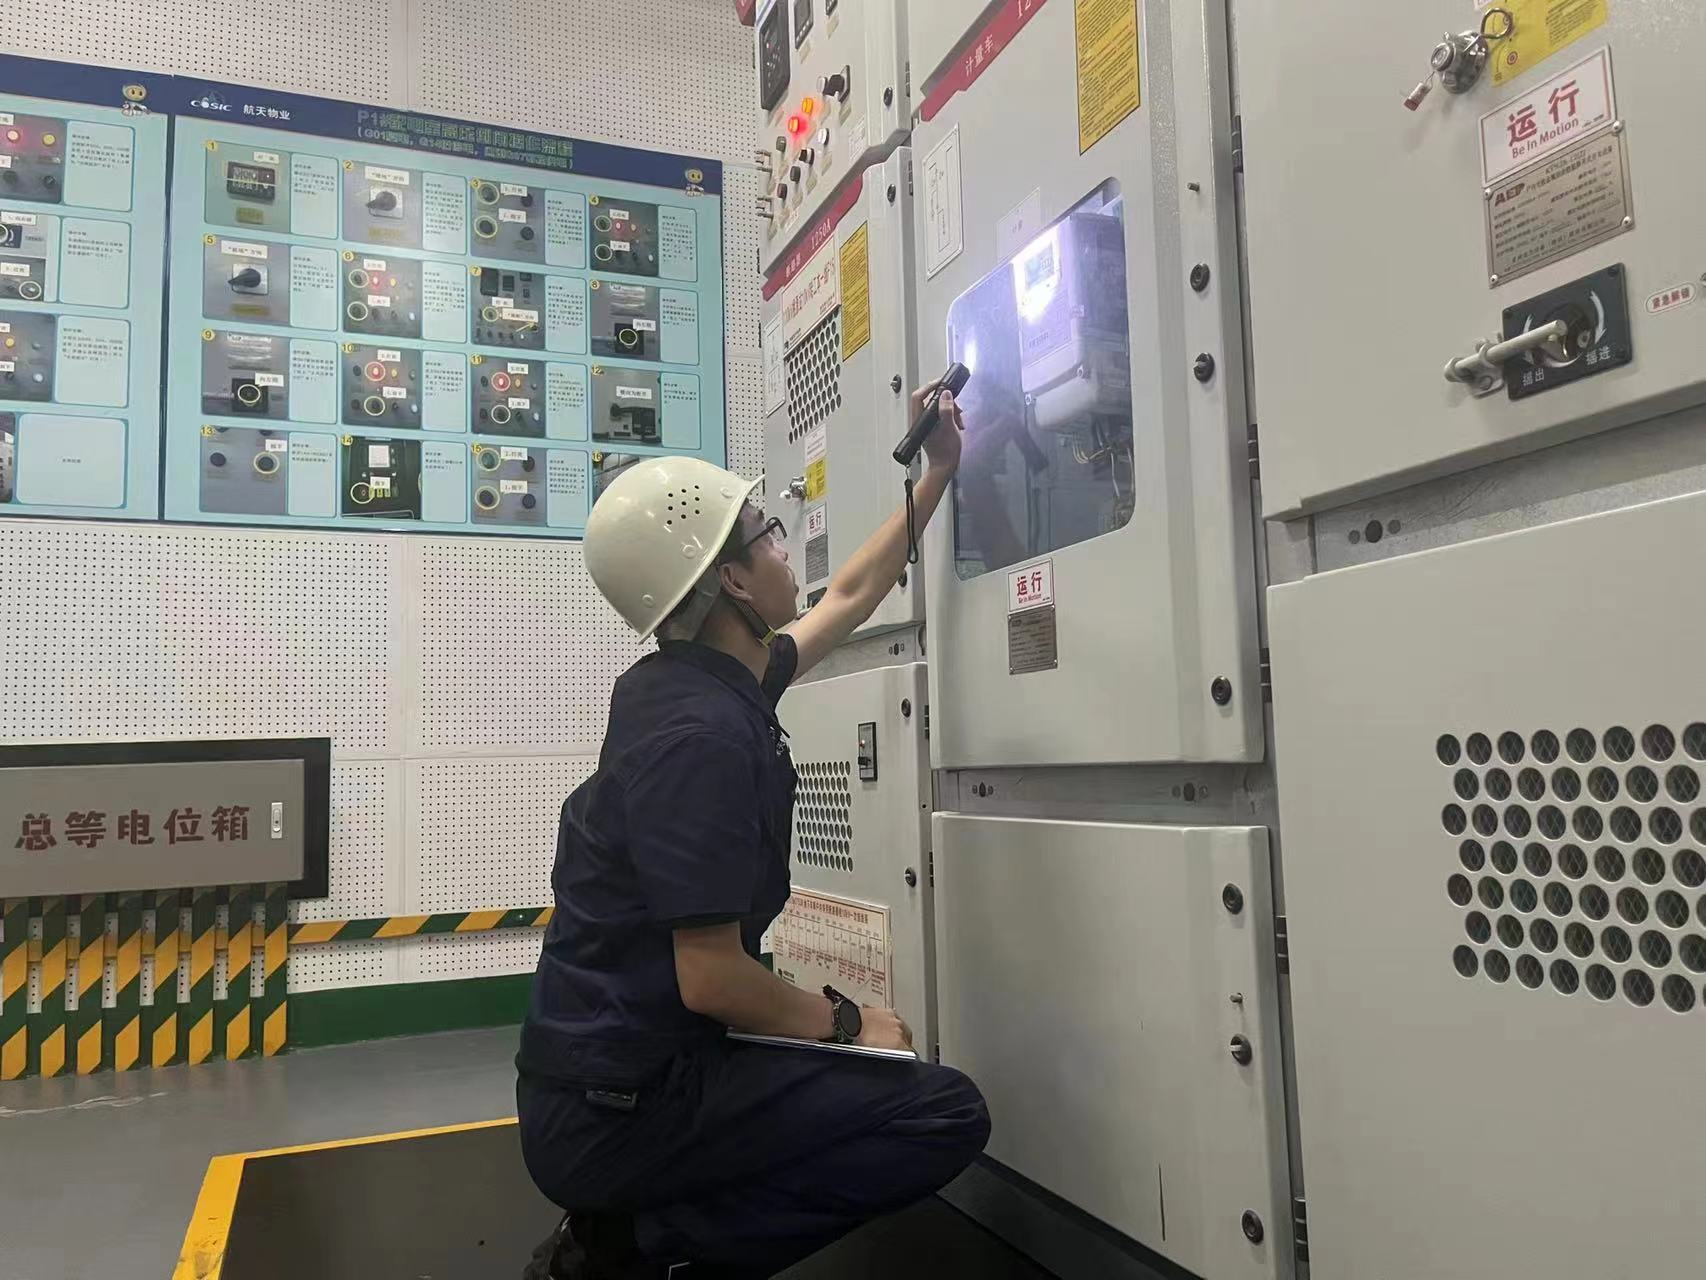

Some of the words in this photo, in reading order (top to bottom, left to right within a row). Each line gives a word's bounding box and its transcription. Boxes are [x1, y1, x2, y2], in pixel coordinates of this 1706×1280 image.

[965, 34, 994, 77] 计量车
[243, 104, 291, 121] 航天物业
[1507, 79, 1580, 147] 运行
[1511, 141, 1526, 159] Be
[1527, 136, 1538, 154] In
[1539, 117, 1579, 146] Motion
[811, 217, 832, 250] 1250A
[1016, 571, 1043, 597] 运行
[14, 804, 250, 851] 总等电位箱
